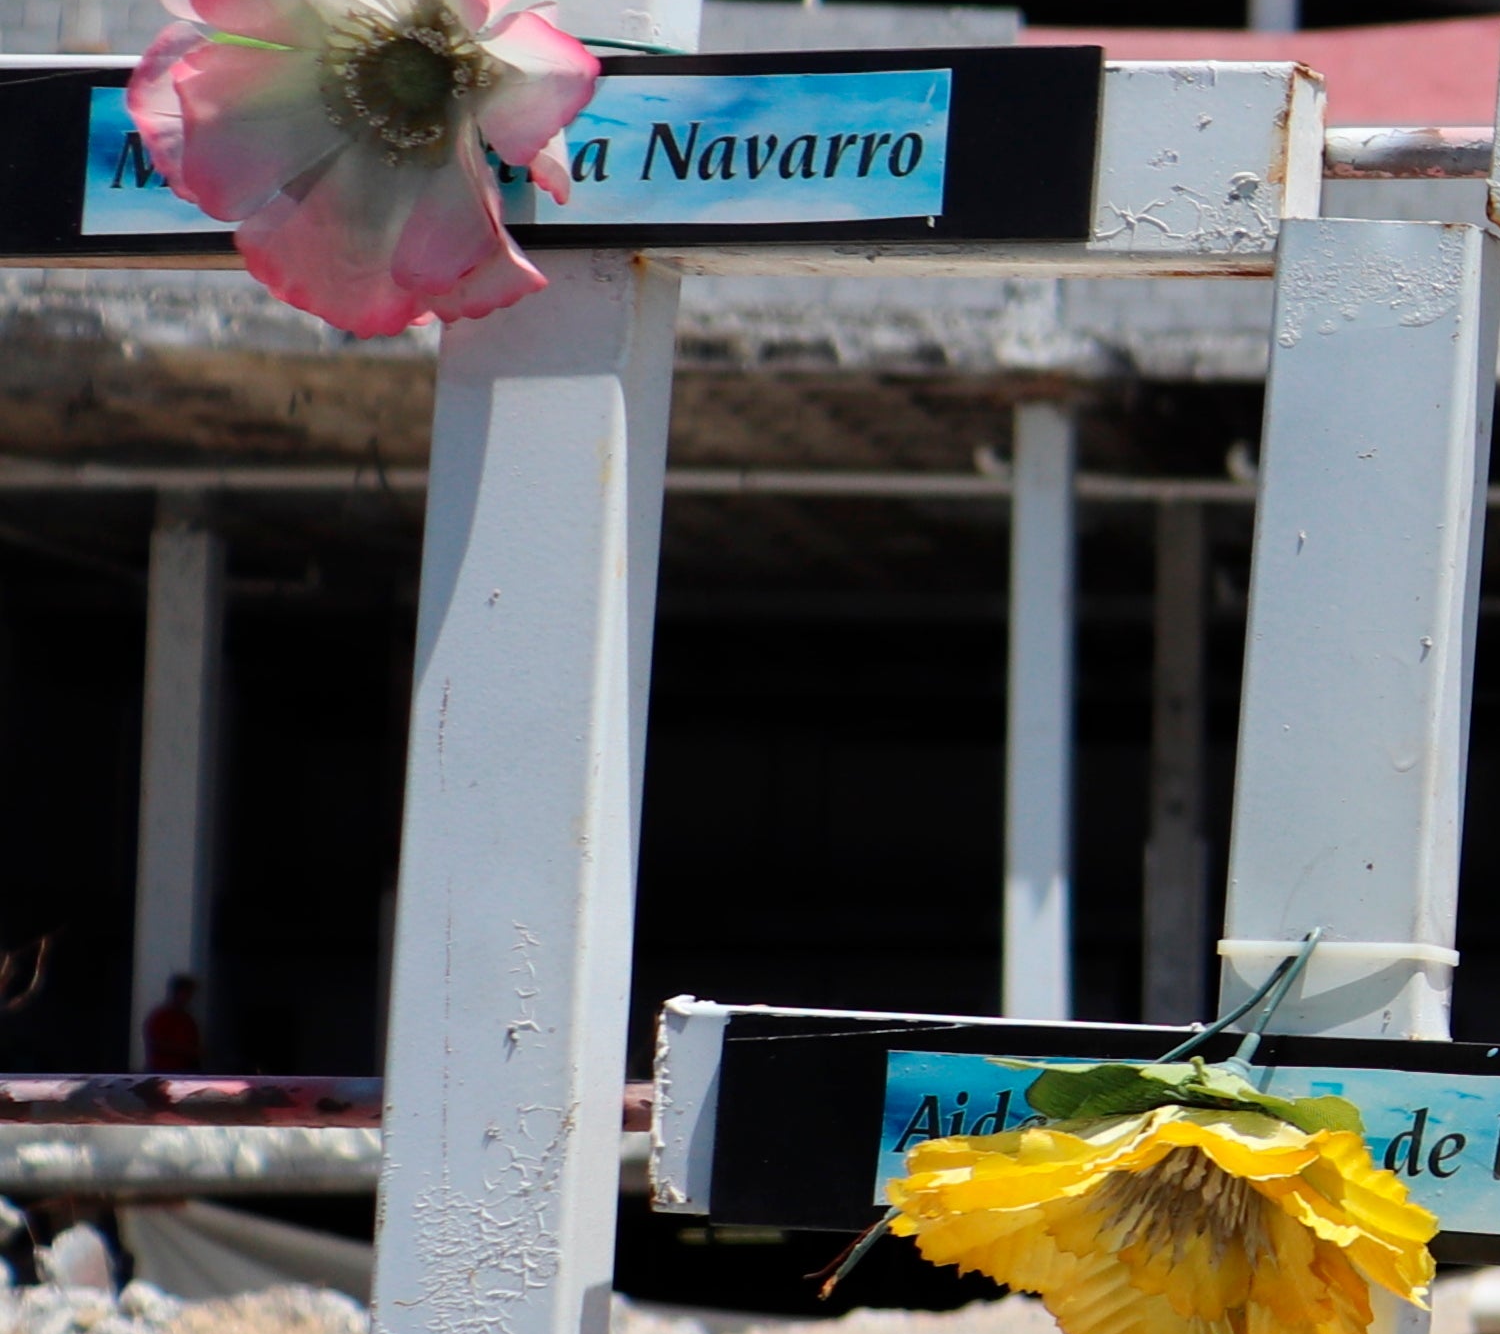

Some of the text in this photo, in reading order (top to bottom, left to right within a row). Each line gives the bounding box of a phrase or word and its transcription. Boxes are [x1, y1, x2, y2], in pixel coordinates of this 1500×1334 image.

[640, 119, 923, 182] Navarro
[893, 1090, 1049, 1153] Aid
[1384, 1107, 1465, 1179] de
